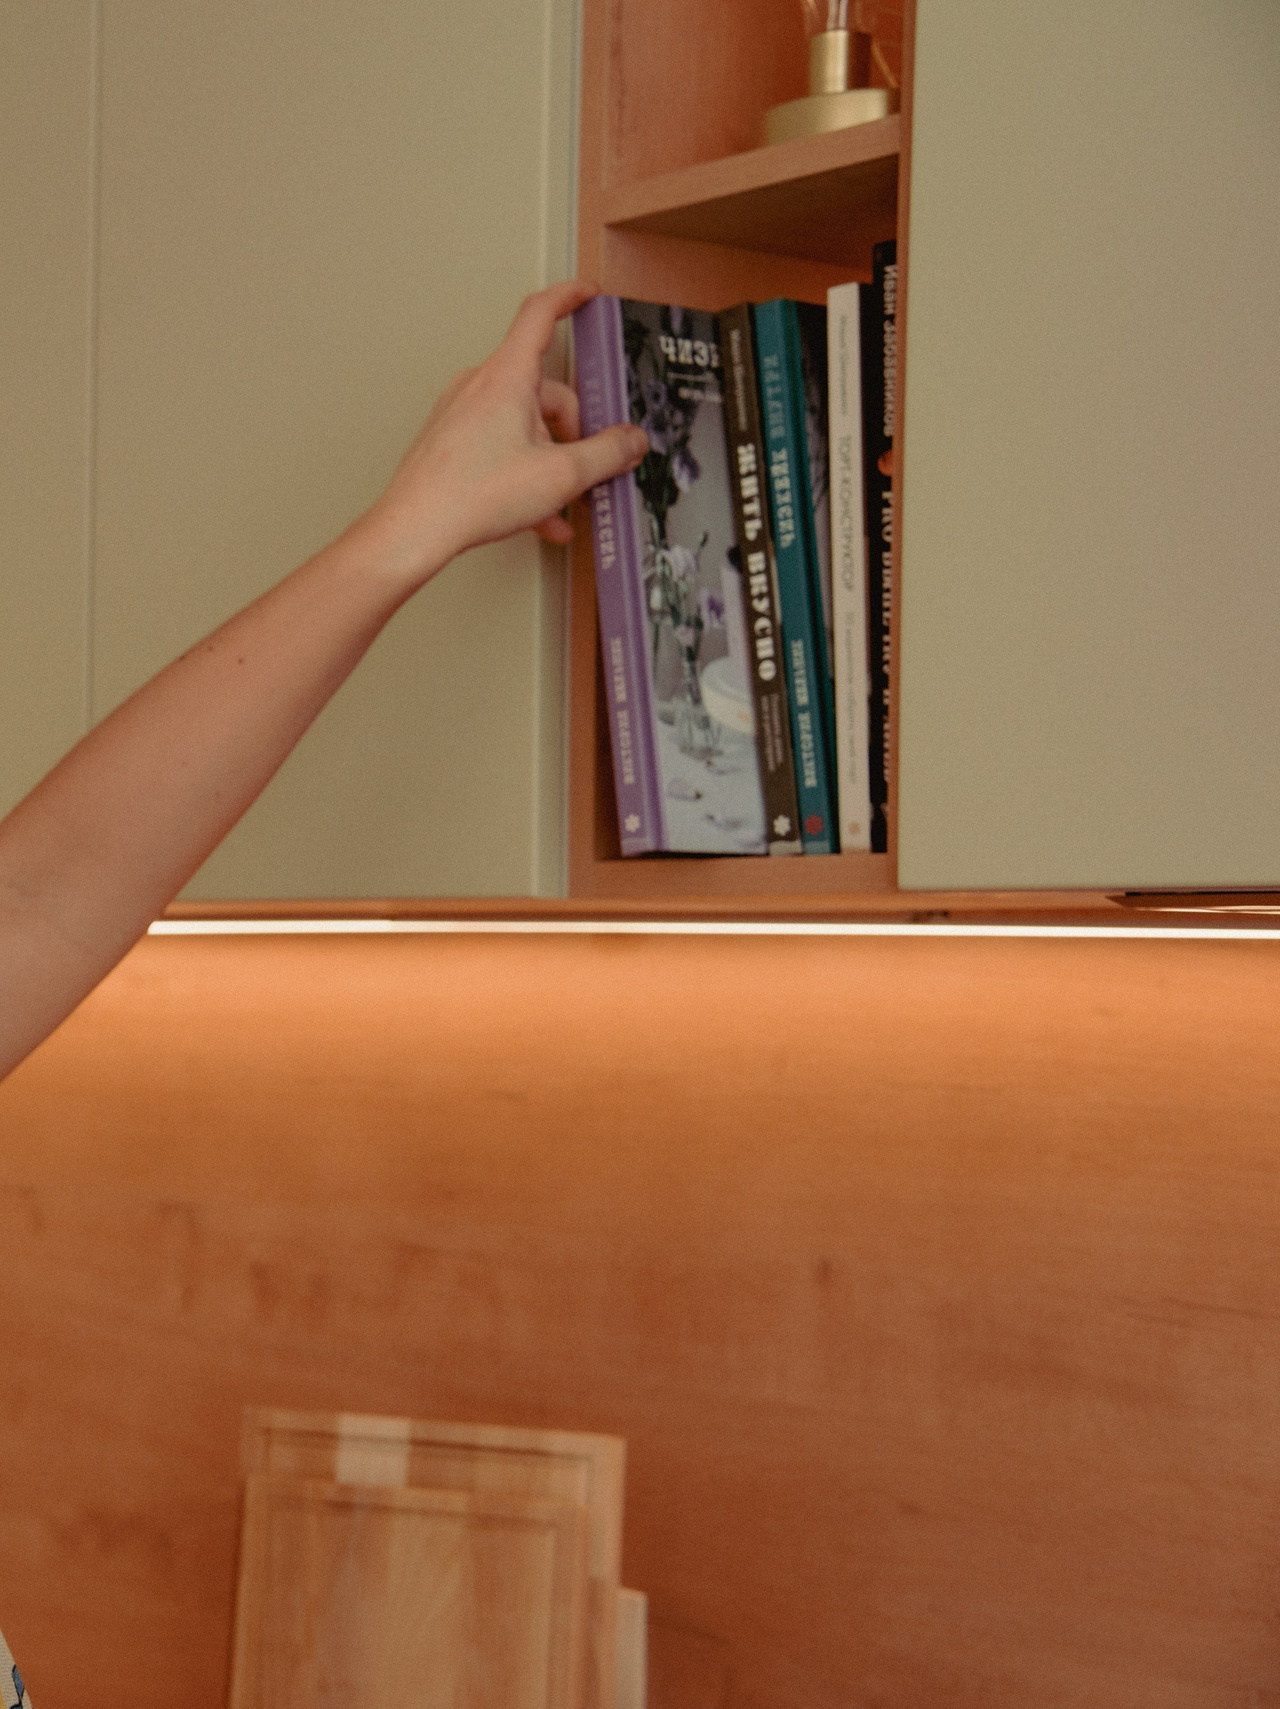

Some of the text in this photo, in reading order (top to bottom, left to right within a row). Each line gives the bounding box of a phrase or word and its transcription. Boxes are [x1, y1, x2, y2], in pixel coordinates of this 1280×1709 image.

[737, 443, 762, 541] ЖИТЬ
[763, 354, 795, 549] ЧИЗКЕЙК ВНУТРИ
[747, 551, 776, 681] ВКУСНО
